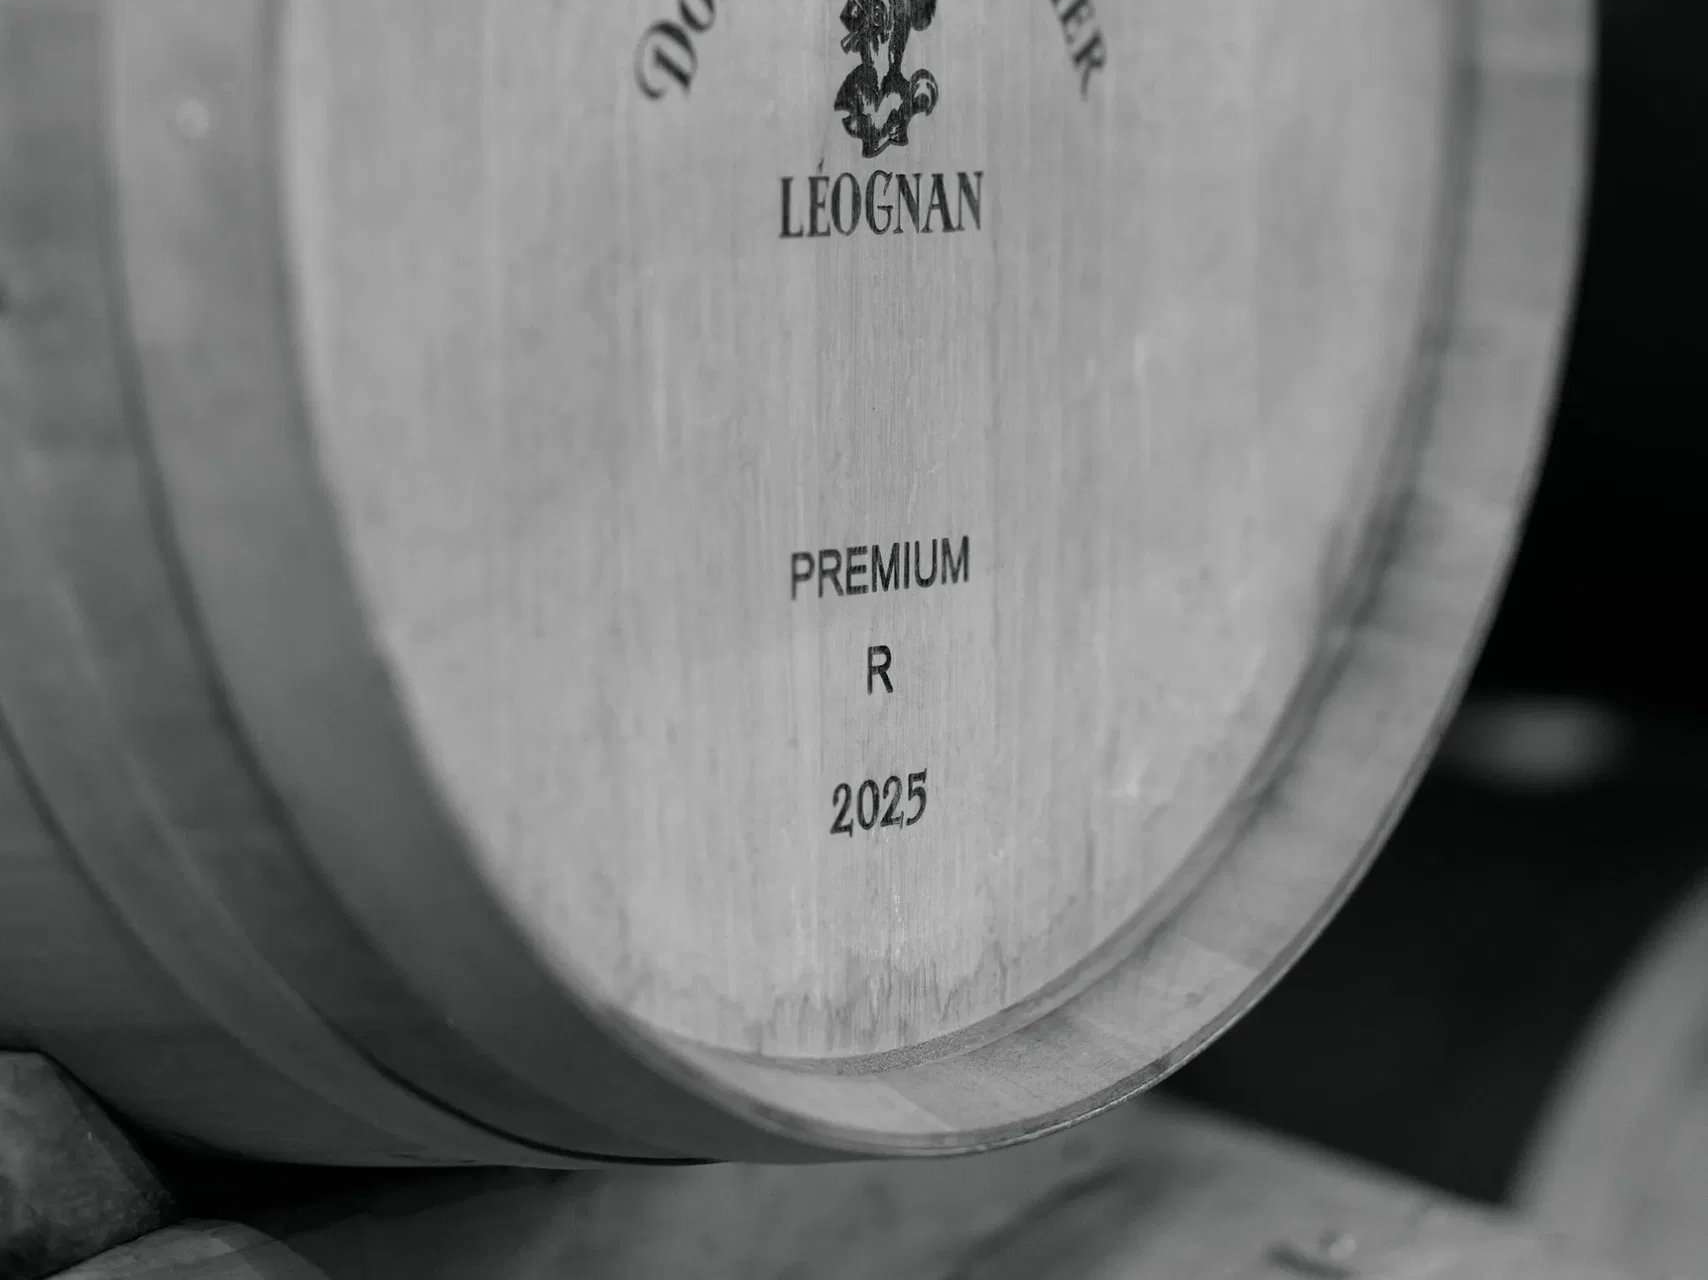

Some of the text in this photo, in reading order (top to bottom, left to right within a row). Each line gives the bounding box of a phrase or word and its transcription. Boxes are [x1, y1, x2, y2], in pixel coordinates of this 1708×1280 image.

[779, 157, 983, 238] LÉOGNAN
[791, 535, 970, 601] PREMIUM
[867, 644, 894, 696] R
[830, 768, 928, 838] 2025
